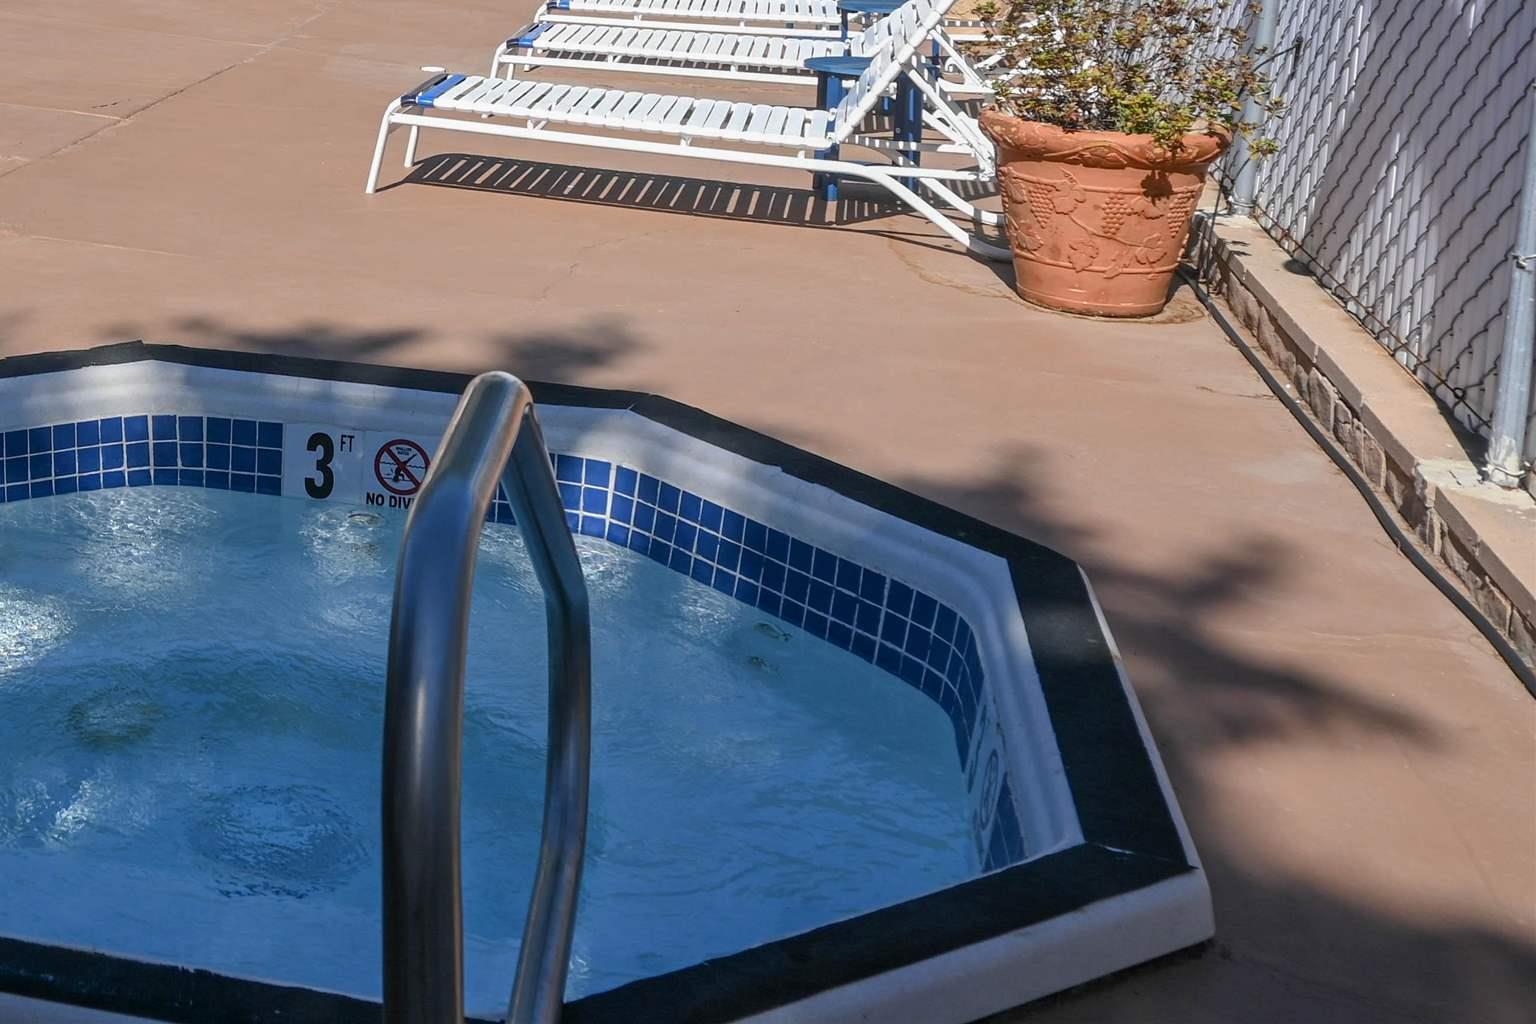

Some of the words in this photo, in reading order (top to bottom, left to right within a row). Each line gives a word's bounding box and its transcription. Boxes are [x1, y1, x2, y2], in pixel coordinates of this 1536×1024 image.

[305, 432, 334, 499] 3
[340, 435, 355, 452] FT
[366, 492, 384, 506] NO
[389, 495, 414, 509] DIV
